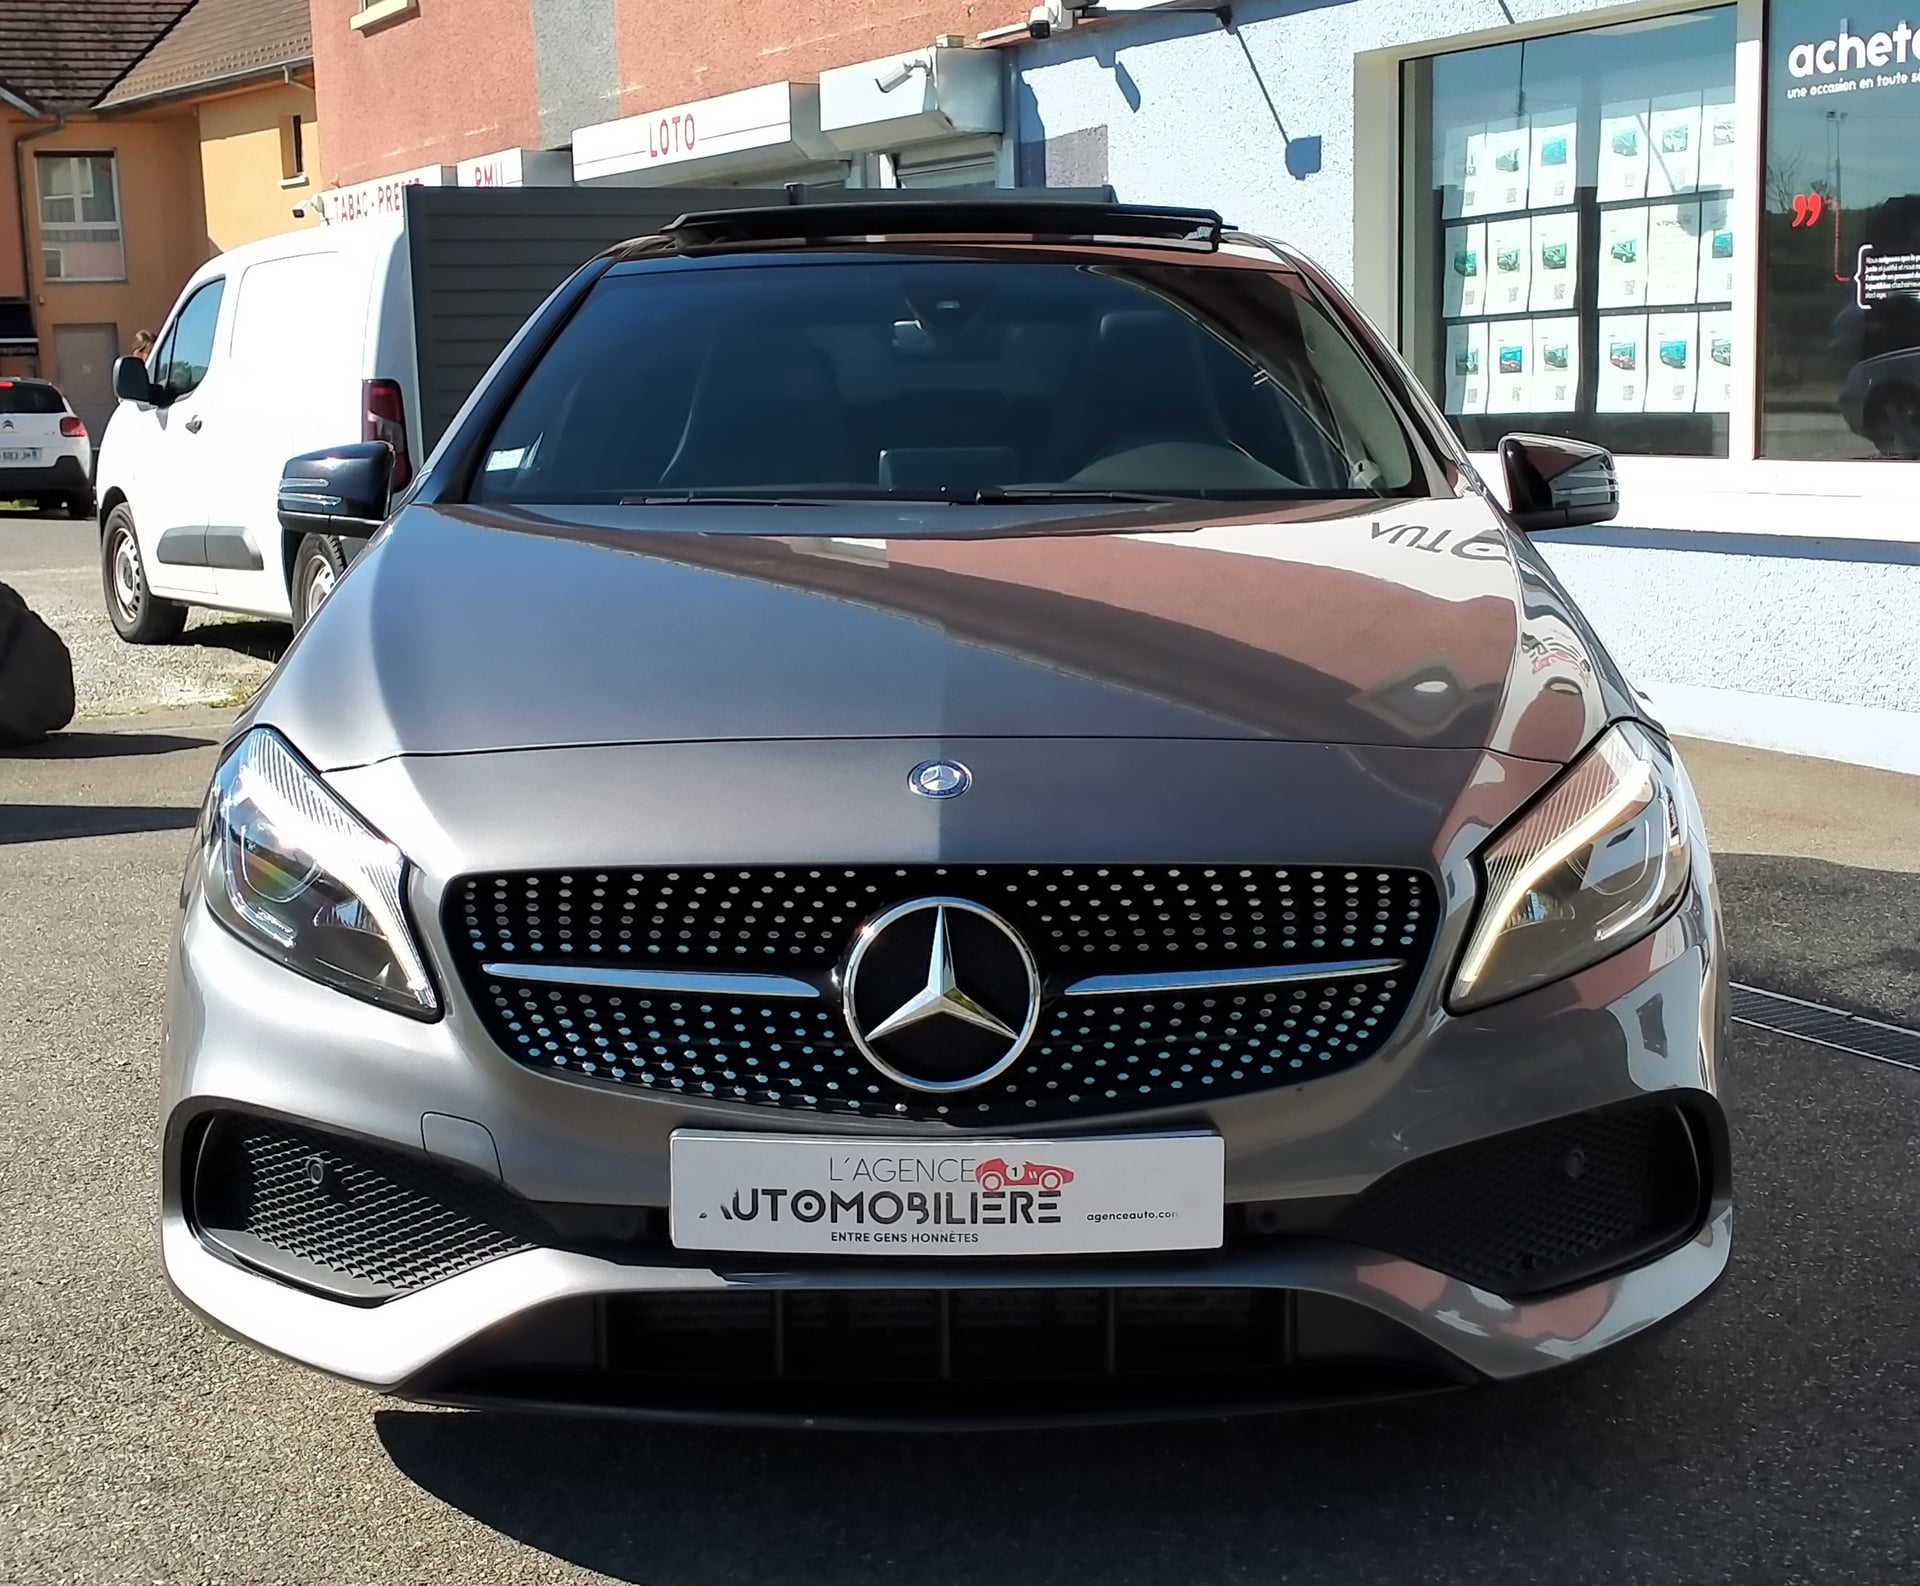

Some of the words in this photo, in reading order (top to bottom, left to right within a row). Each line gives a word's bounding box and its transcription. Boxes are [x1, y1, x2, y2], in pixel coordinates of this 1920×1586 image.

[1787, 88, 1808, 99] une
[1859, 77, 1874, 90] en
[1876, 71, 1909, 88] toute
[649, 113, 695, 158] LOTO
[333, 191, 369, 226] TABAC
[829, 1156, 976, 1183] L'AGENCE
[698, 1187, 1062, 1225] UTOMOBILIERE
[831, 1231, 871, 1243] ENTRE
[873, 1232, 908, 1243] GENS
